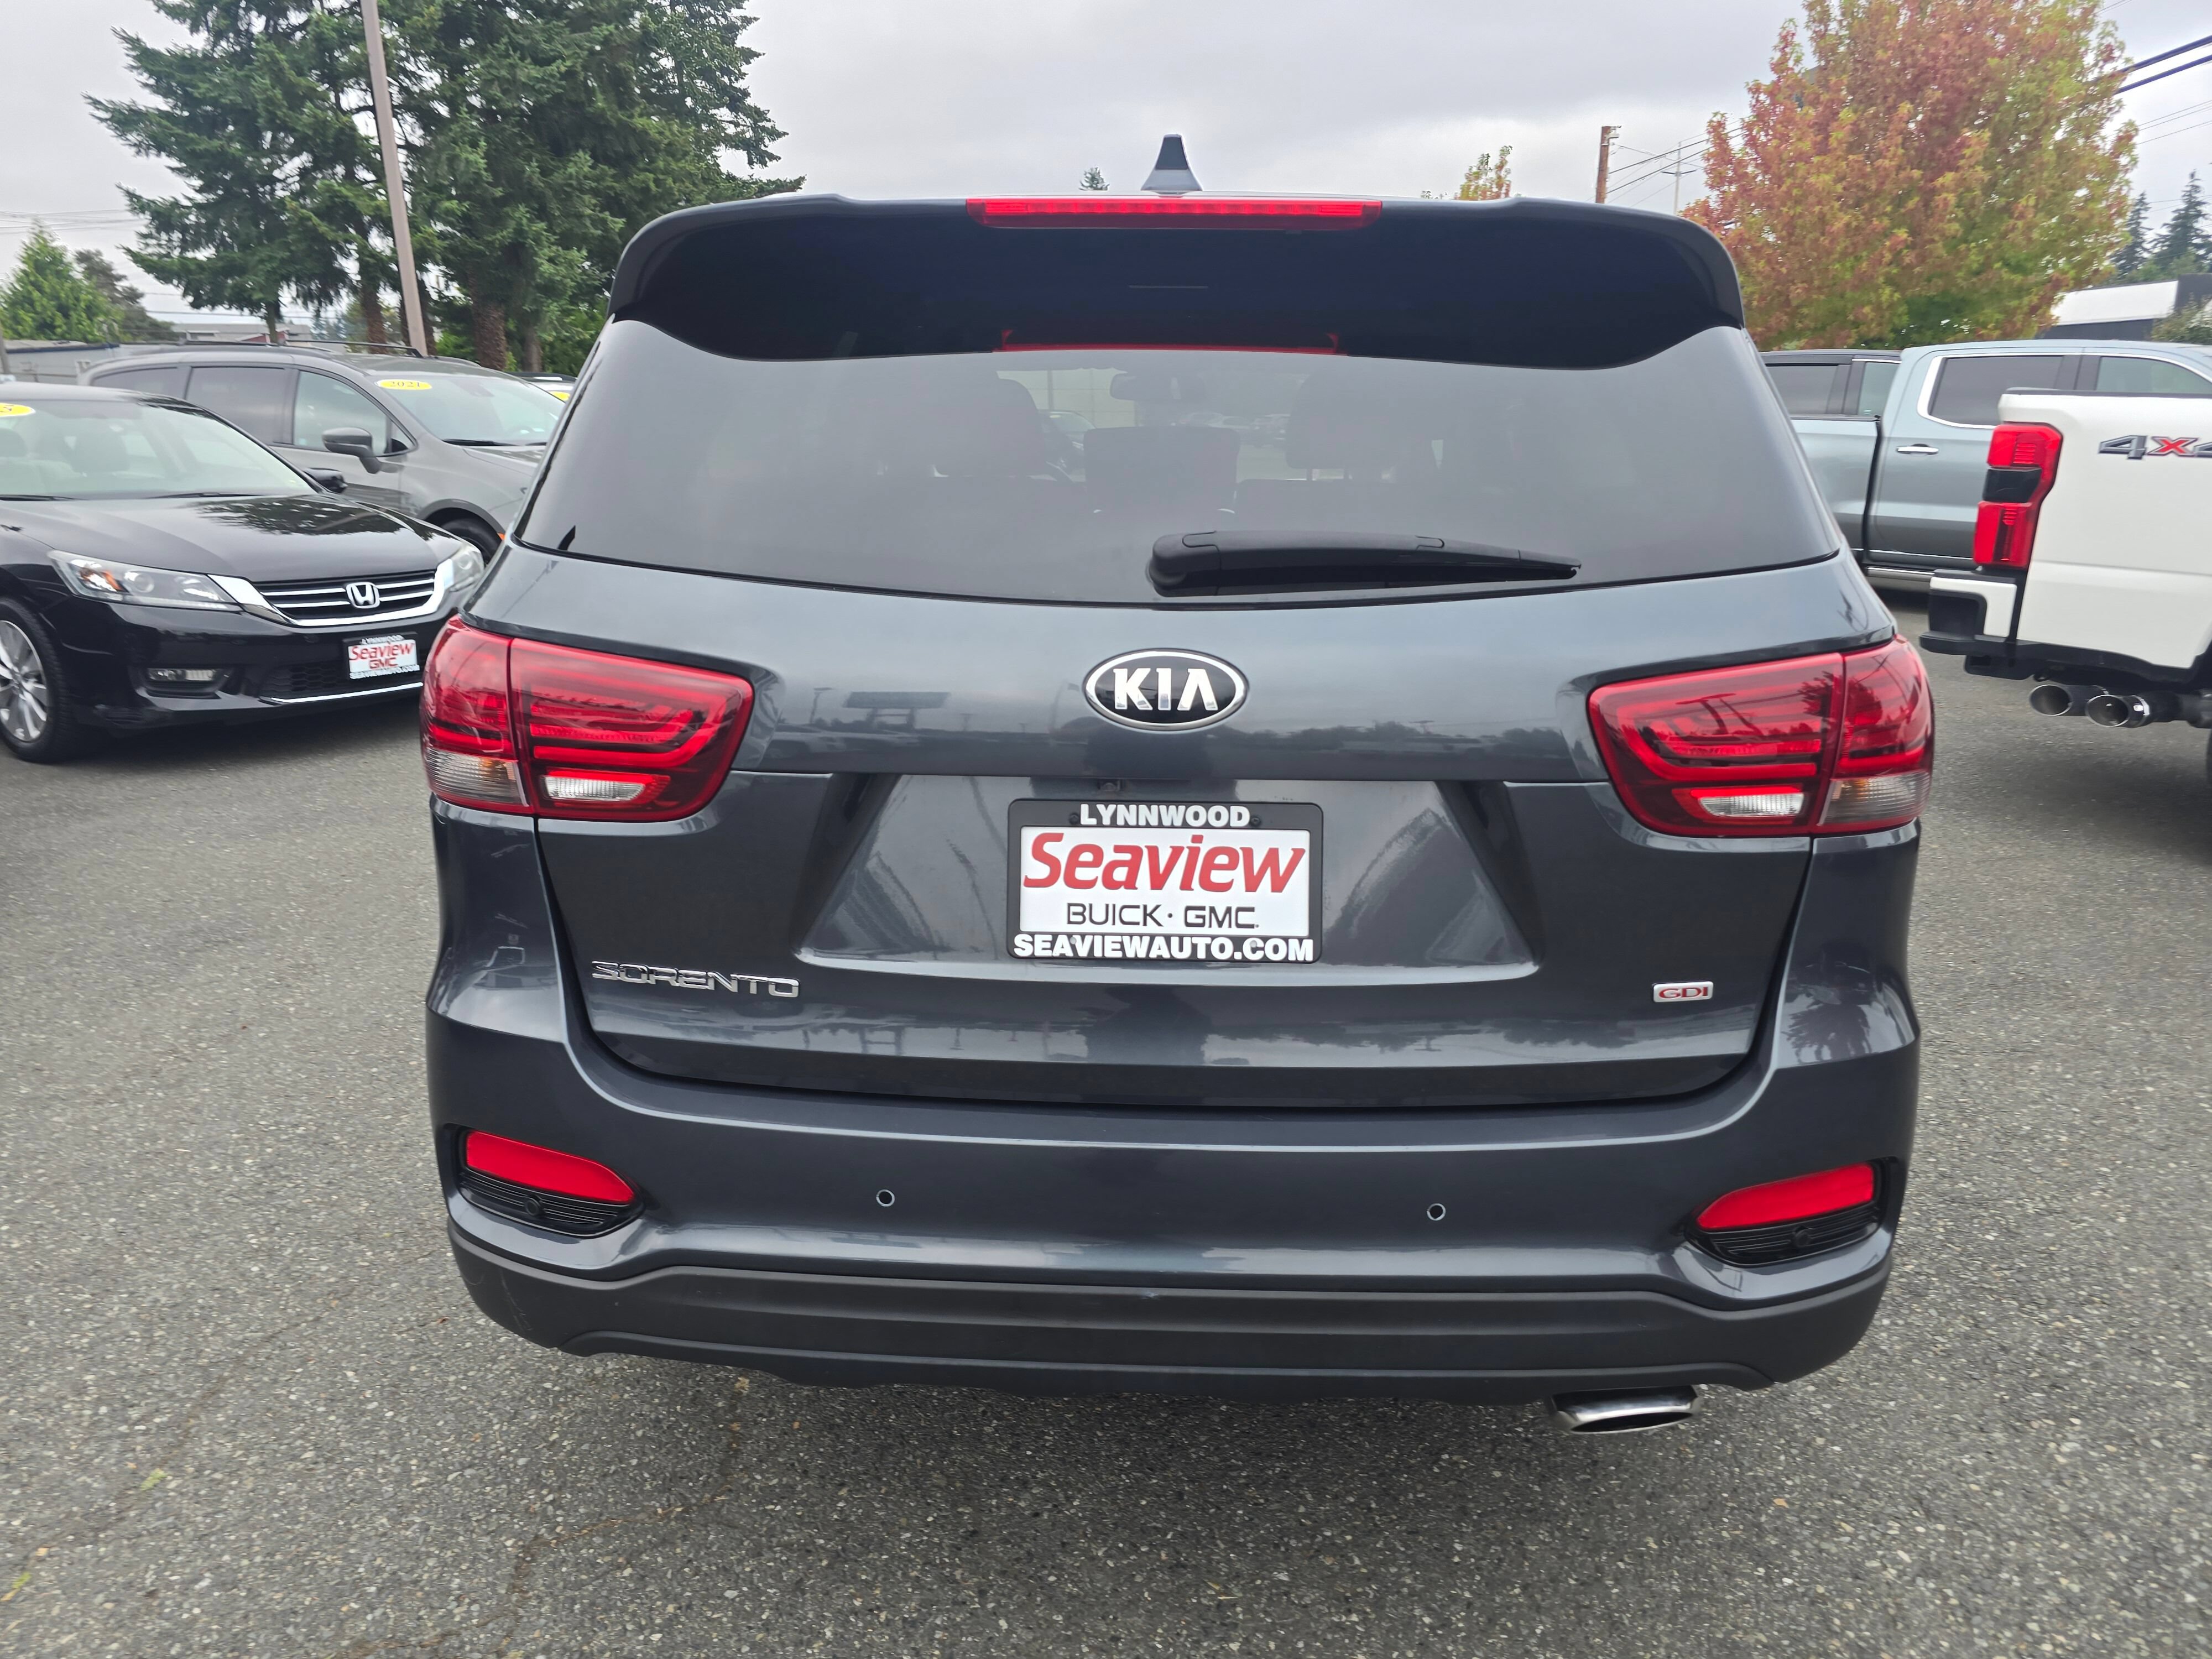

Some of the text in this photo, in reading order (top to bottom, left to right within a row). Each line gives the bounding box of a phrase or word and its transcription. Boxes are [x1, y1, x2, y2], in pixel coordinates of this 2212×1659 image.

[349, 643, 414, 661] Seaview
[370, 657, 398, 669] GMC
[1113, 667, 1219, 711] KIA
[1079, 804, 1251, 827] LYNNWOOD
[1023, 832, 1306, 893] Seaview
[1066, 902, 1259, 928] BUICK GMC
[1014, 933, 1314, 962] SEAVIEWAUTO.COM
[591, 960, 801, 998] SORENTO
[1658, 987, 1708, 999] GDI
